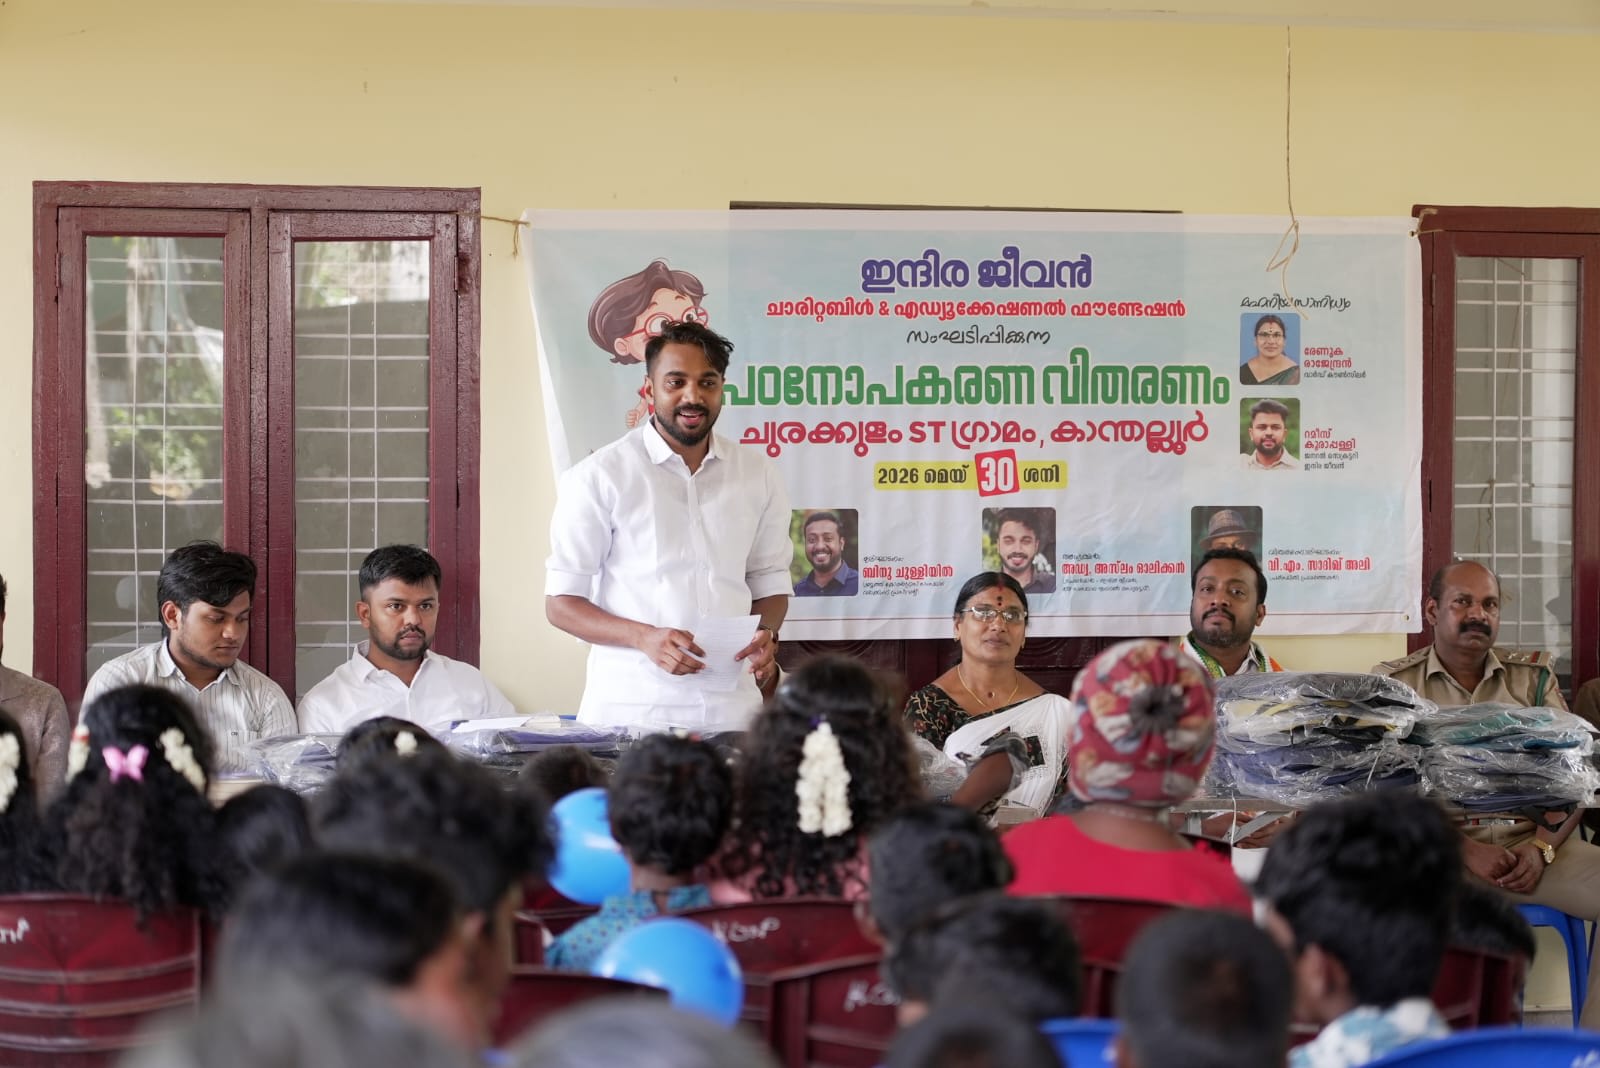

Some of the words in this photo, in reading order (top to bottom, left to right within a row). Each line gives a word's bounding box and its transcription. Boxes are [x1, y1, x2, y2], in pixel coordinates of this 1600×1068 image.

[861, 249, 969, 293] ഇന്ദിര
[977, 245, 1093, 289] ജീവൻ
[878, 302, 890, 317] &
[907, 325, 1051, 345] സംഘടിപ്പിക്കുന്ന
[1043, 347, 1231, 407] വിതരണം
[909, 420, 946, 443] ST
[878, 468, 919, 484] 2026
[924, 465, 970, 484] മെയ്
[980, 457, 1014, 492] 30
[1023, 464, 1060, 483] ശനി
